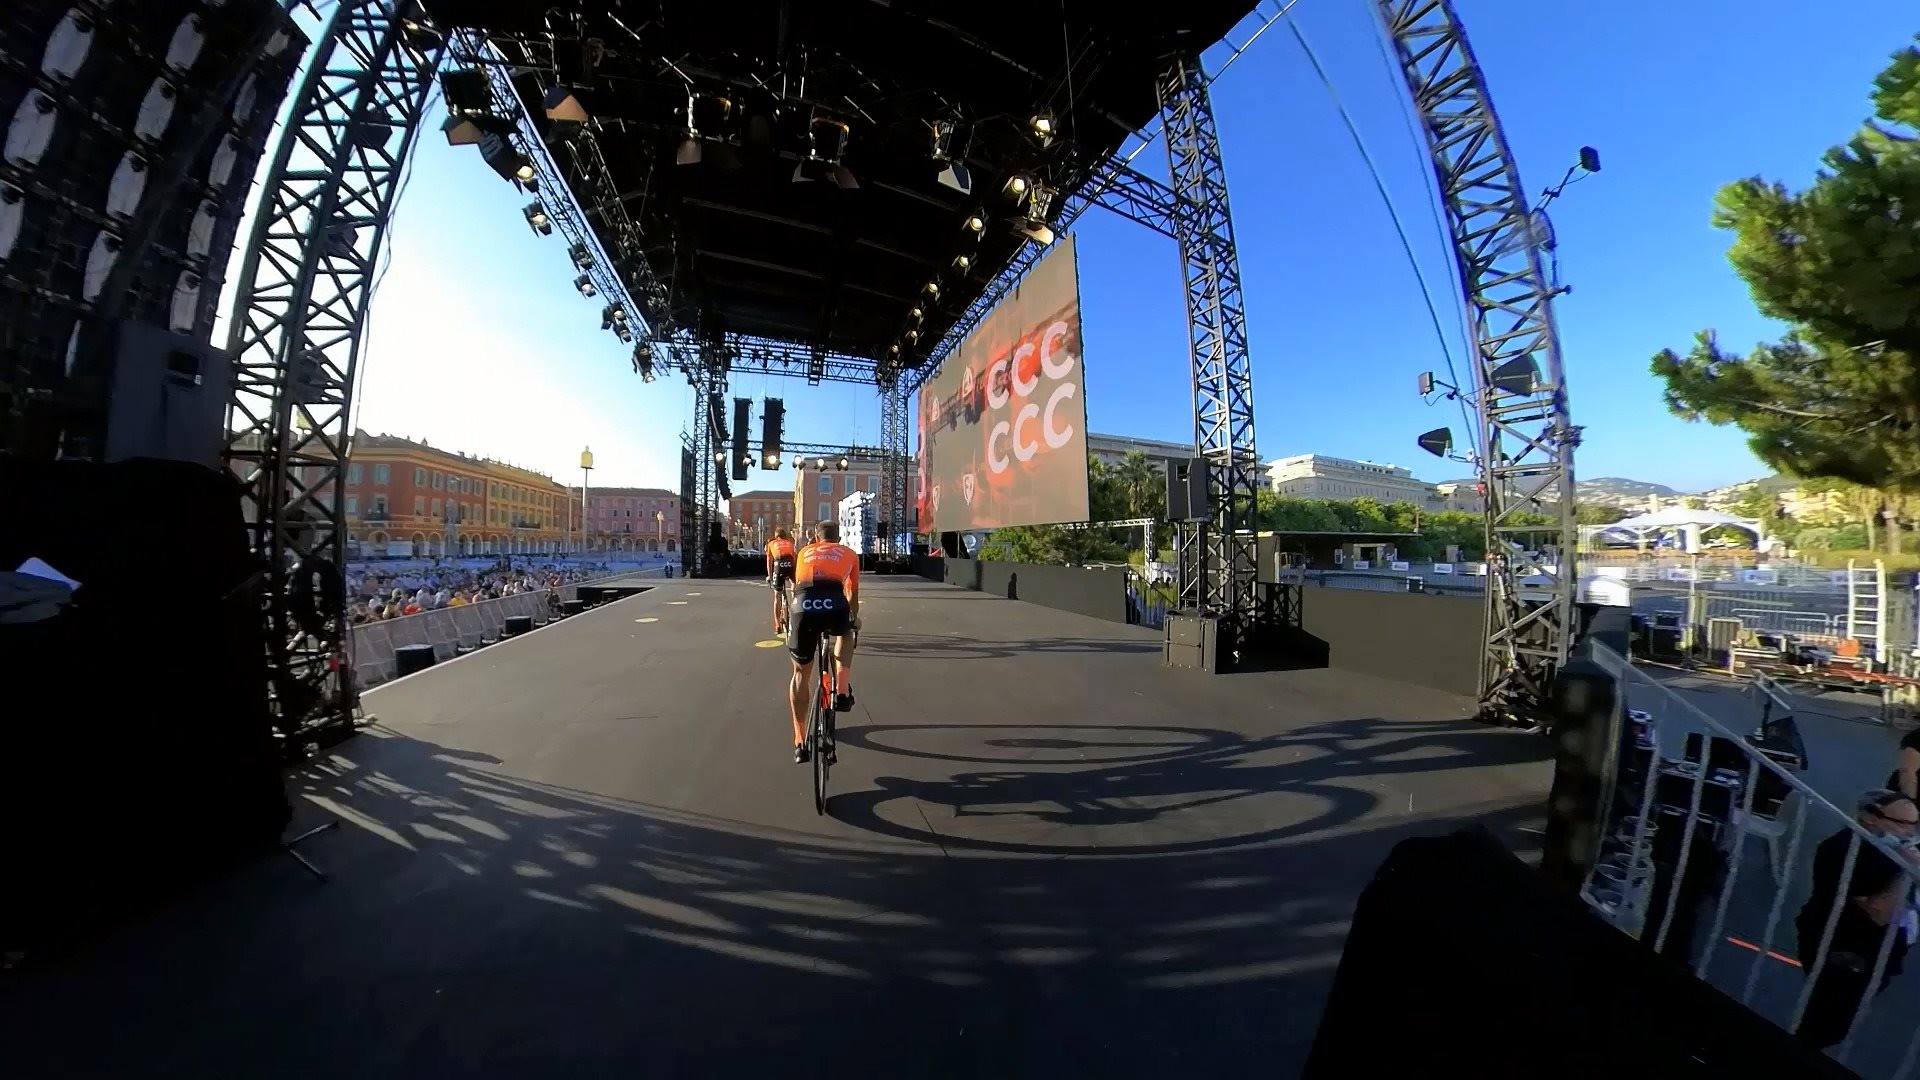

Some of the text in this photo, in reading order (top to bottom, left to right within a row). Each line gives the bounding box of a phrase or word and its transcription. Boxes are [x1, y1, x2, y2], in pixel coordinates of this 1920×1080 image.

[987, 321, 1075, 409] CCC
[989, 383, 1076, 474] CCC
[803, 598, 832, 610] CCC
